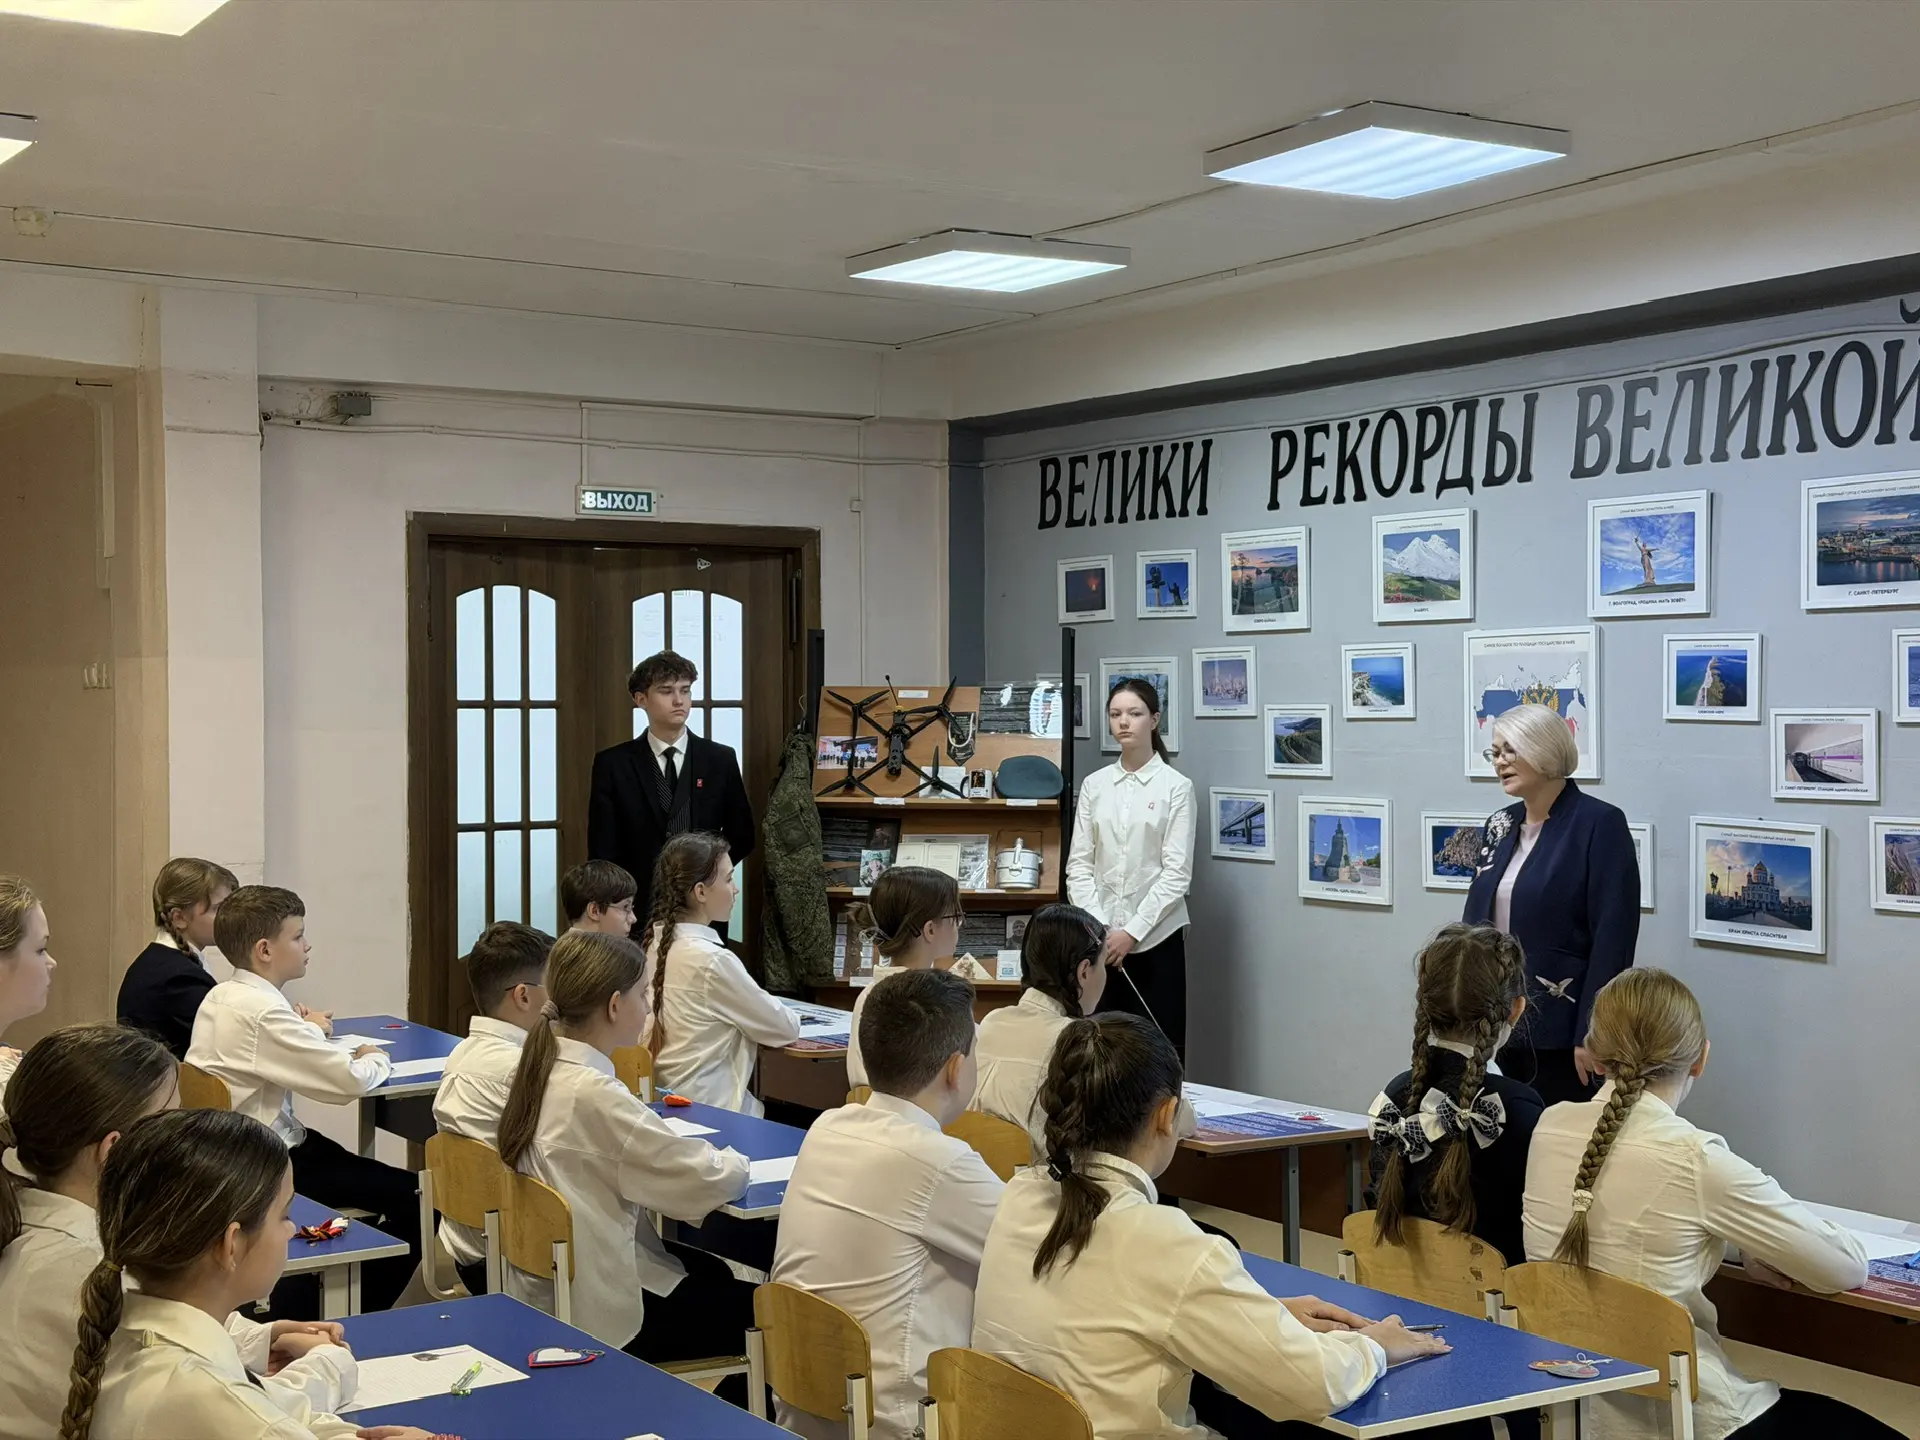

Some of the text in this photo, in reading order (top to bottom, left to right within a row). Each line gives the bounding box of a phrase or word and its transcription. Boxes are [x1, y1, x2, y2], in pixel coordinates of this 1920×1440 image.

[1038, 438, 1213, 530] ВЕЛИКИ
[1267, 392, 1539, 511] РЕКОРДЫ
[584, 491, 649, 512] ВЫХОД
[1854, 588, 1900, 597] САНКТ-ПЕТЕРБУРГ
